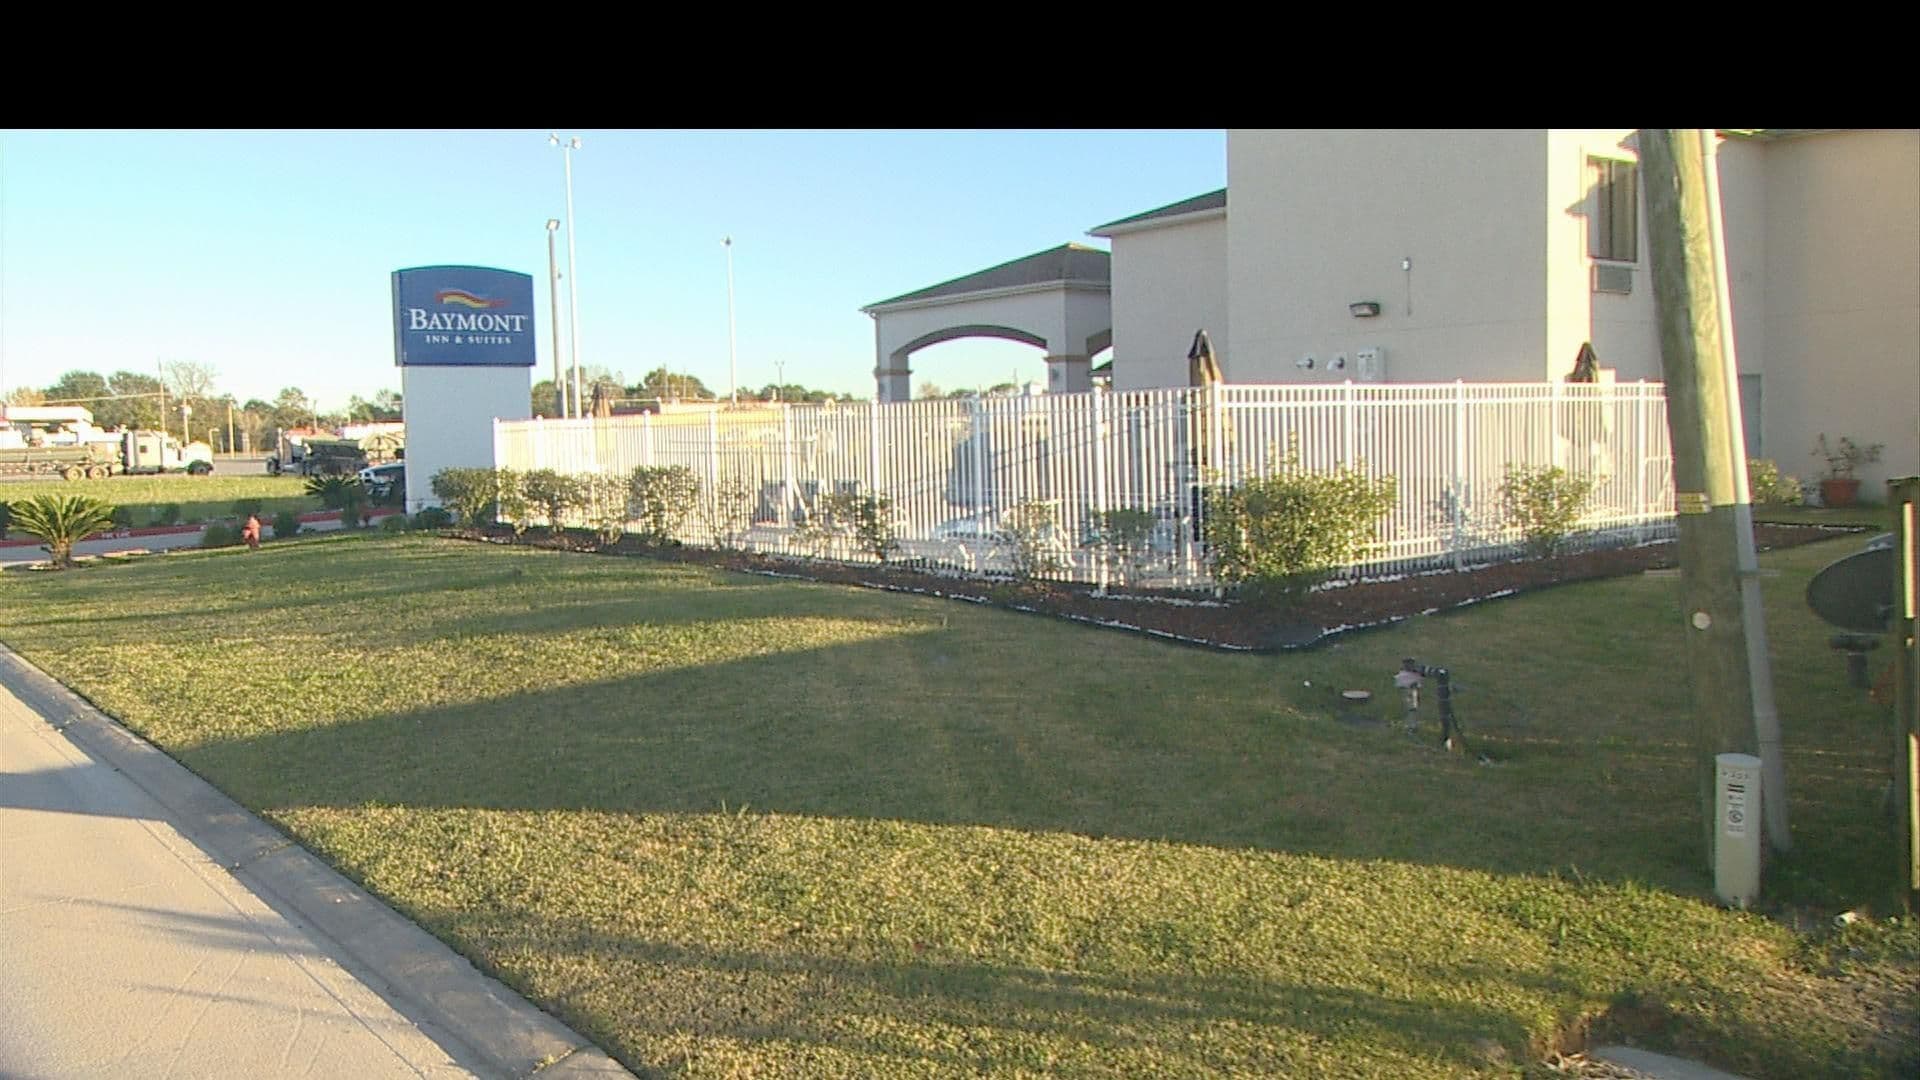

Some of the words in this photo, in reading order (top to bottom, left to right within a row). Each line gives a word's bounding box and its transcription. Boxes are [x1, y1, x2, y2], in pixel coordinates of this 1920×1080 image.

[409, 308, 525, 332] BAYMONT
[425, 335, 450, 344] INN
[455, 335, 464, 344] &
[468, 335, 512, 345] SUITES
